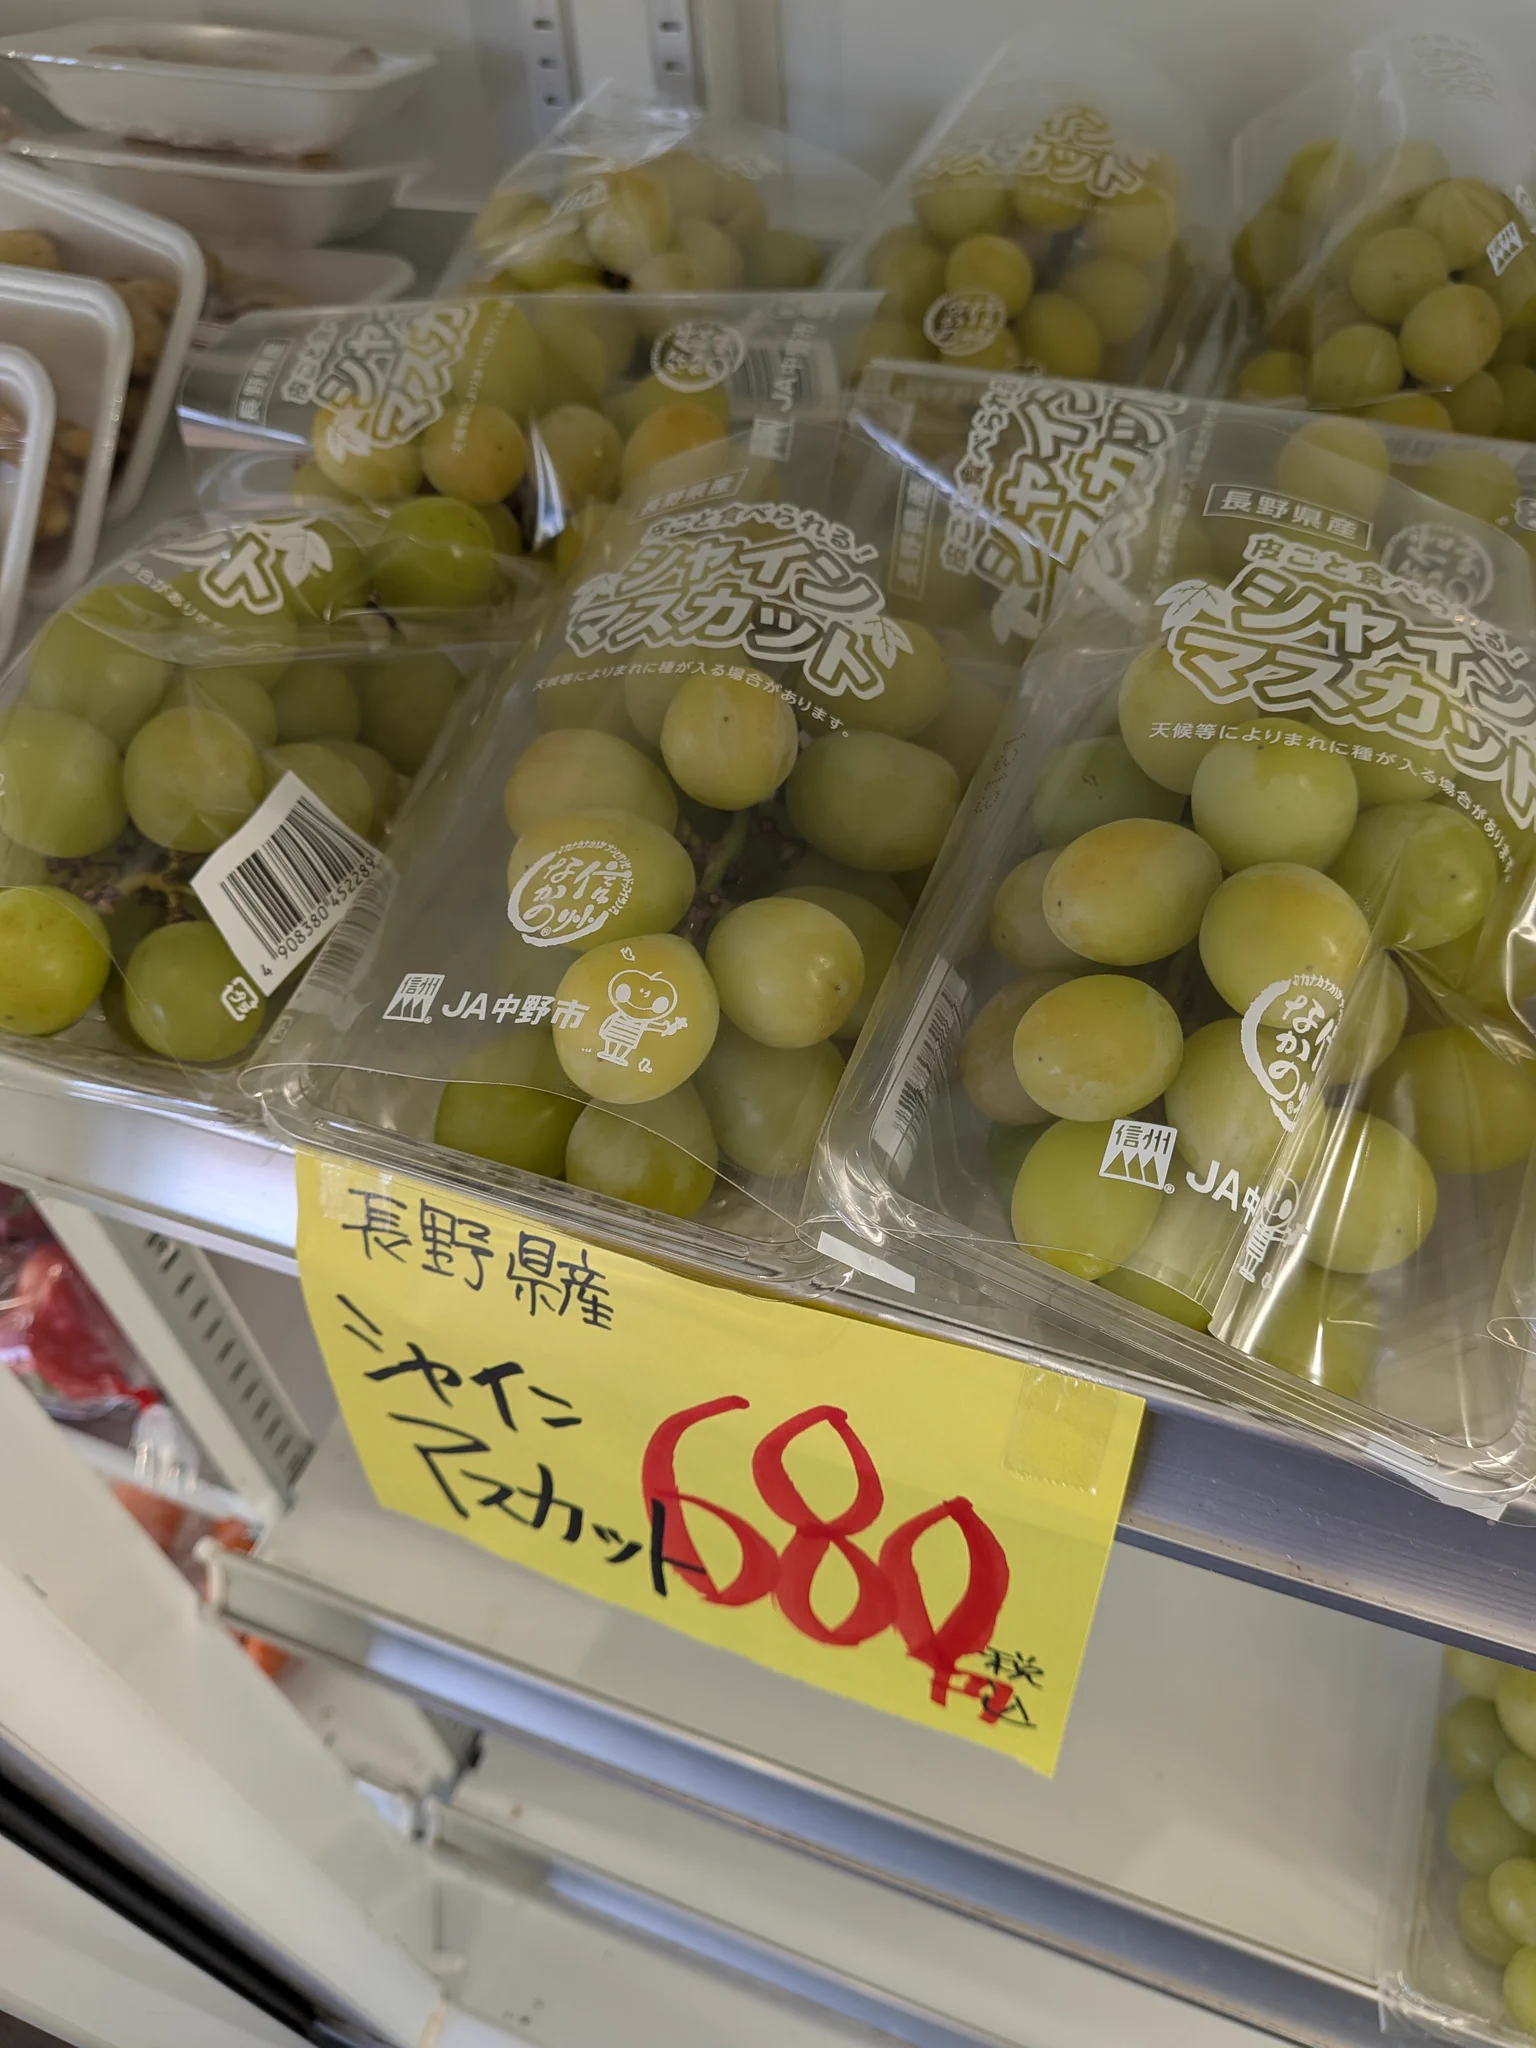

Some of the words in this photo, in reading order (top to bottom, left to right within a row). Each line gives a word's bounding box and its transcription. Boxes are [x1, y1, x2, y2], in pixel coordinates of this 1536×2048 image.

[1219, 487, 1359, 543] 長野県産
[616, 538, 884, 612] シャイン
[568, 582, 884, 698] マスカット
[1233, 567, 1536, 724] シャイン
[277, 905, 329, 960] 908380
[330, 856, 376, 908] 452289
[442, 990, 591, 1030] JA中野市
[1115, 1123, 1172, 1156] 信州
[342, 1189, 614, 1331] 長野県産
[390, 1412, 707, 1597] マスカット
